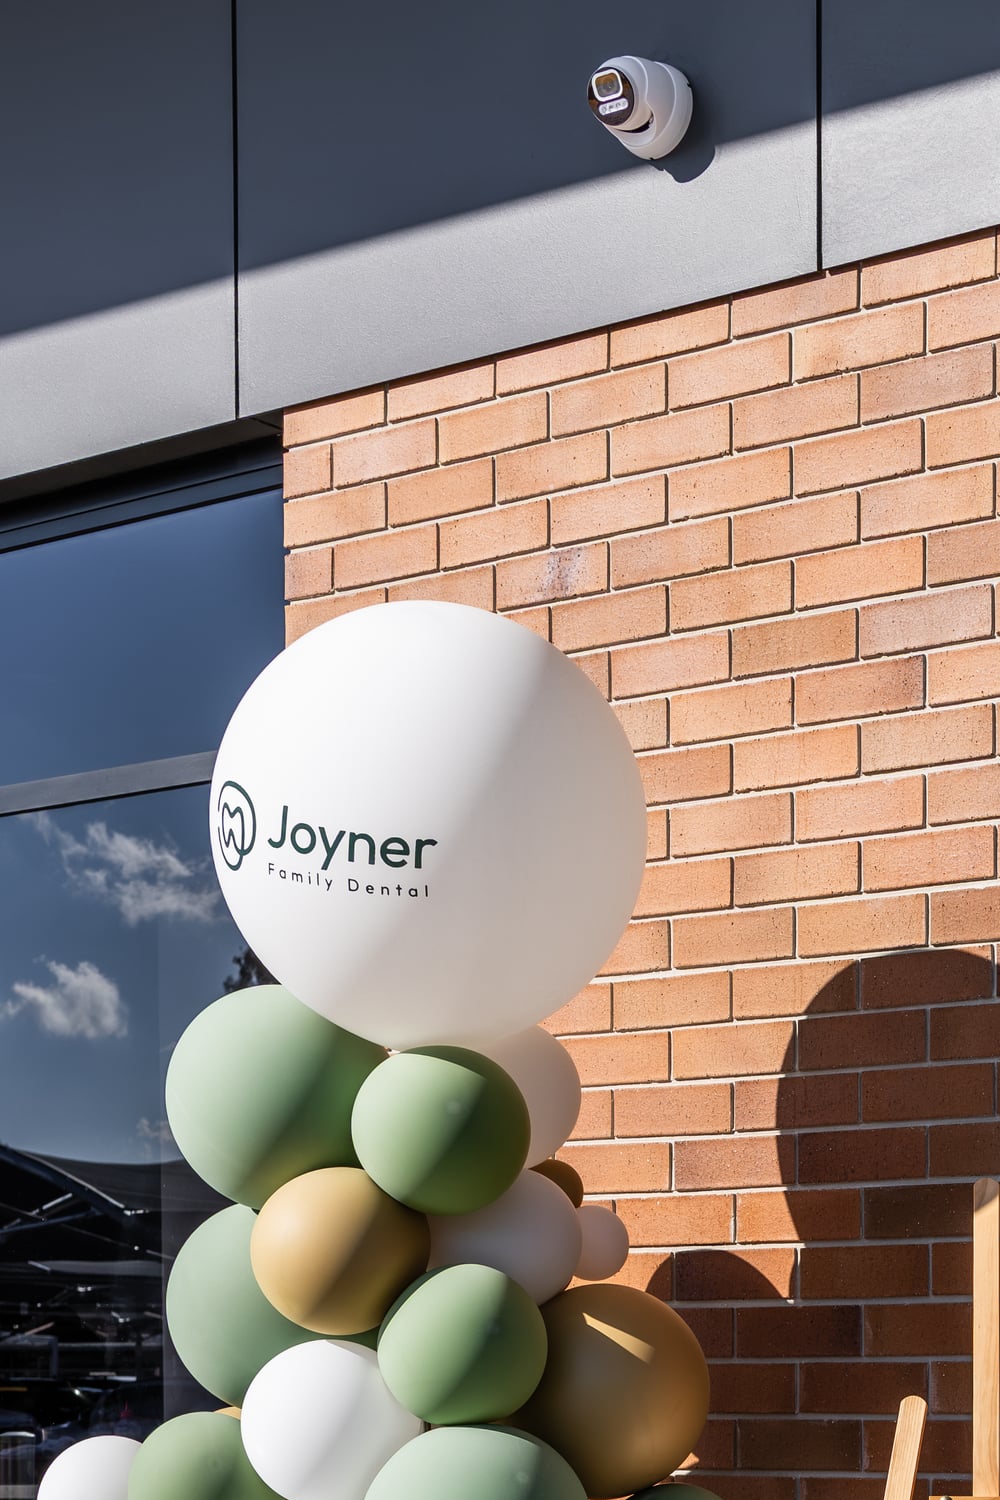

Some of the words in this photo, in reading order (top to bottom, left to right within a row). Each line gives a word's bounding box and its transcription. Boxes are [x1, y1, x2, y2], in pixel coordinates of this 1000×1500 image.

[267, 805, 439, 872] Joyner
[268, 861, 333, 892] Family
[347, 878, 429, 898] Dental
